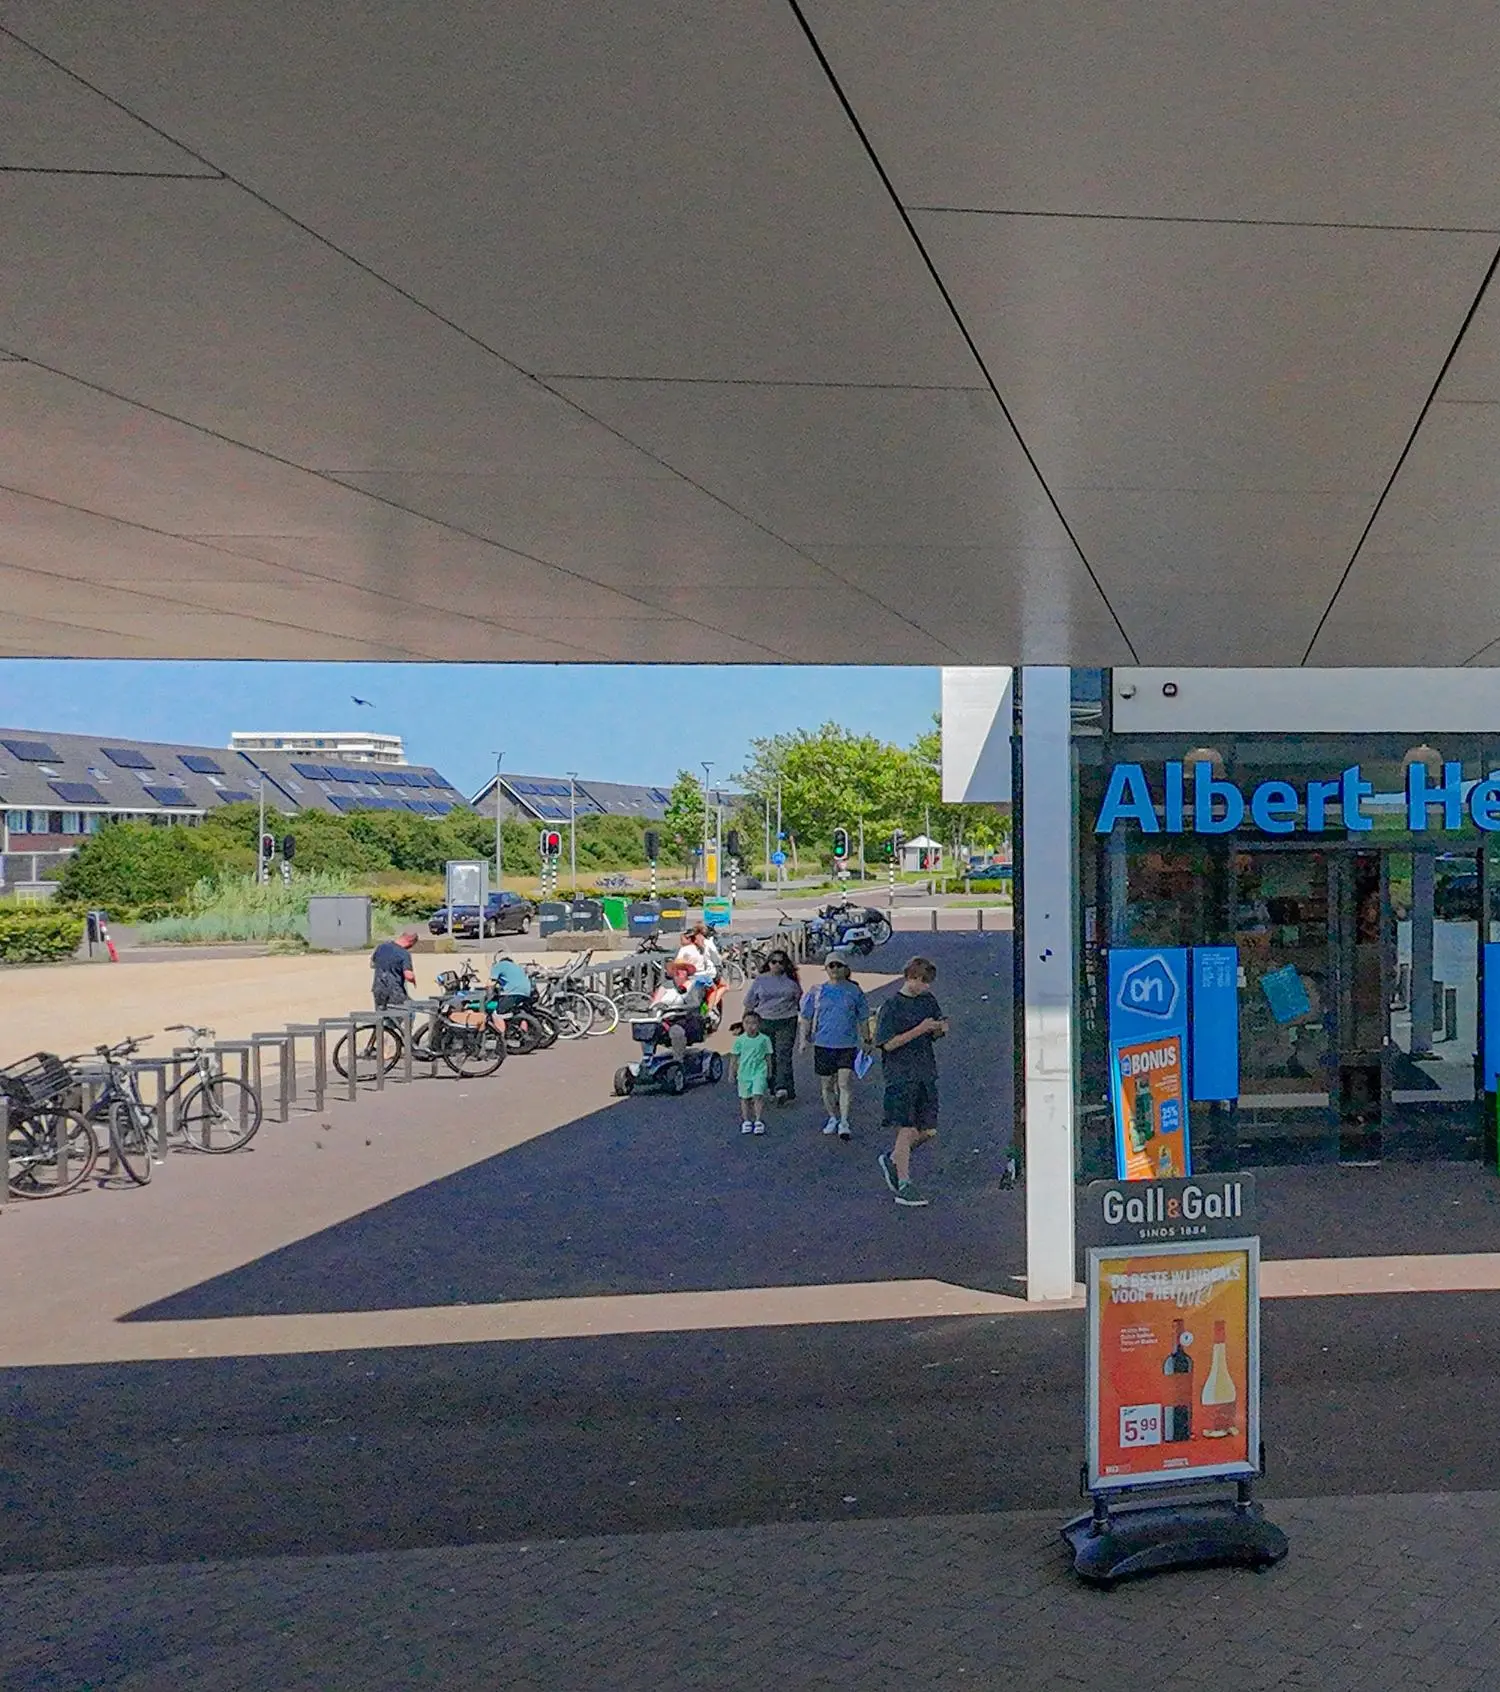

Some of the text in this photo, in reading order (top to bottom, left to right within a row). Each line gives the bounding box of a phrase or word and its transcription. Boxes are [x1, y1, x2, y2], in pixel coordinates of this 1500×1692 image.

[1093, 760, 1373, 834] Albert
[1130, 1046, 1177, 1074] BONUS
[1103, 1183, 1242, 1225] Gall&Gall
[1139, 1226, 1175, 1238] SINDS
[1111, 1287, 1147, 1304] VOOR
